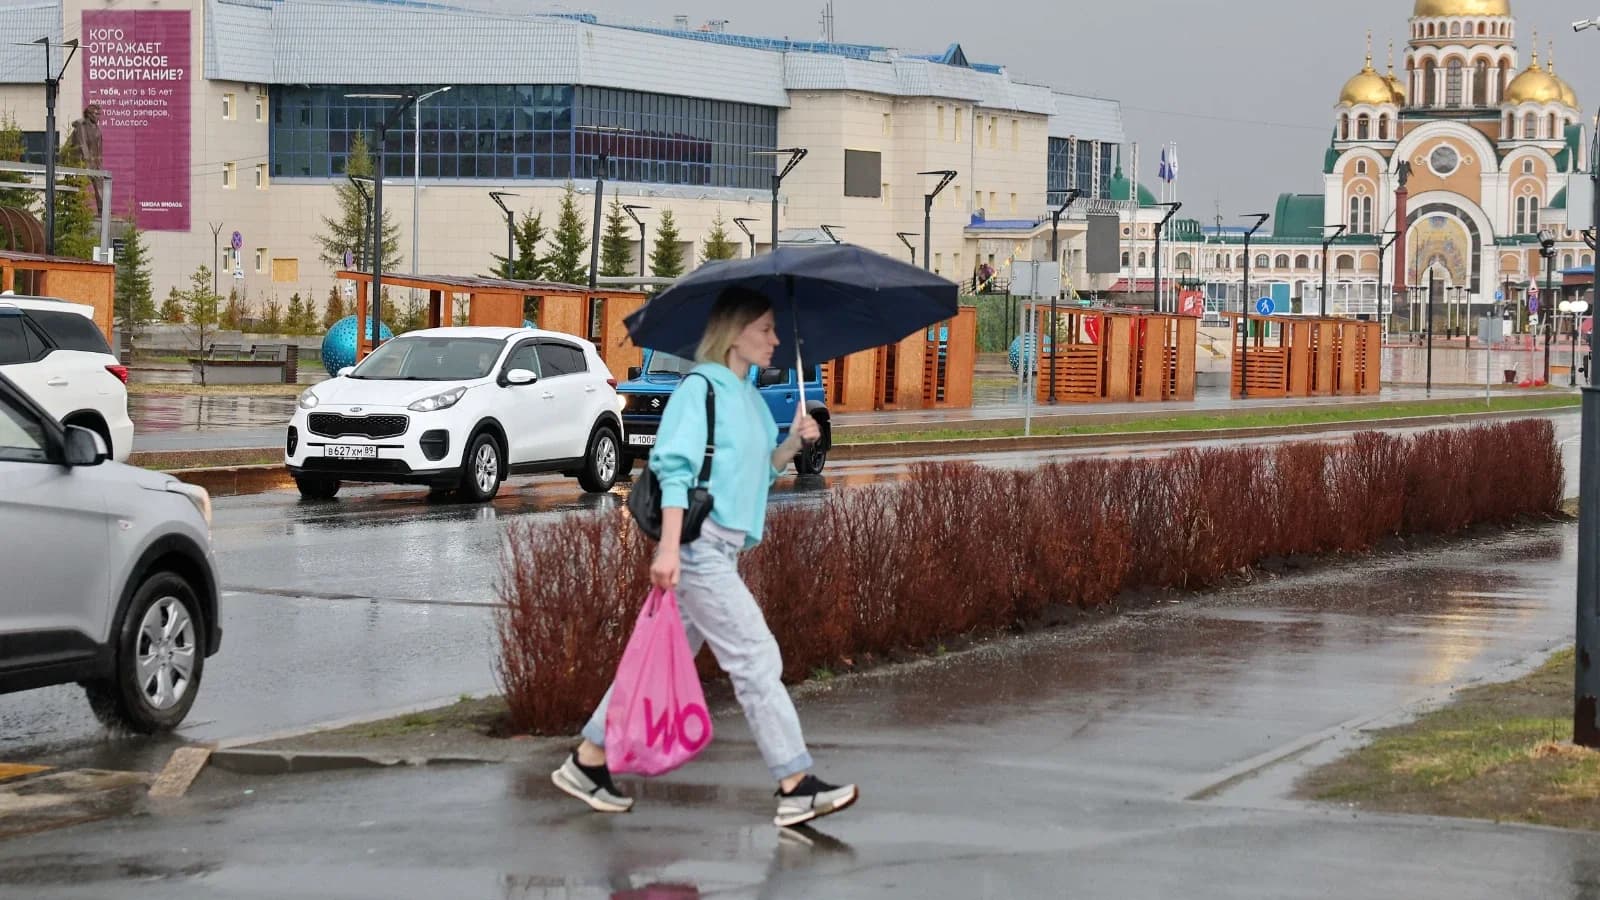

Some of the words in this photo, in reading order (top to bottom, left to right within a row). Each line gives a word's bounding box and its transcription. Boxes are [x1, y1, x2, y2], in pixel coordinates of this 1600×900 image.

[89, 28, 124, 41] КОГО
[89, 42, 162, 54] ОТРАЖАЕТ
[89, 55, 169, 67] ЯМАЛЬСКОЕ
[89, 69, 184, 80] ВОСПИТАНИЕ?
[100, 87, 121, 97] тебя,
[158, 88, 173, 96] лет
[118, 99, 168, 107] цитировать
[102, 109, 131, 117] только
[133, 109, 170, 118] рэперов,
[110, 118, 148, 127] Толстого
